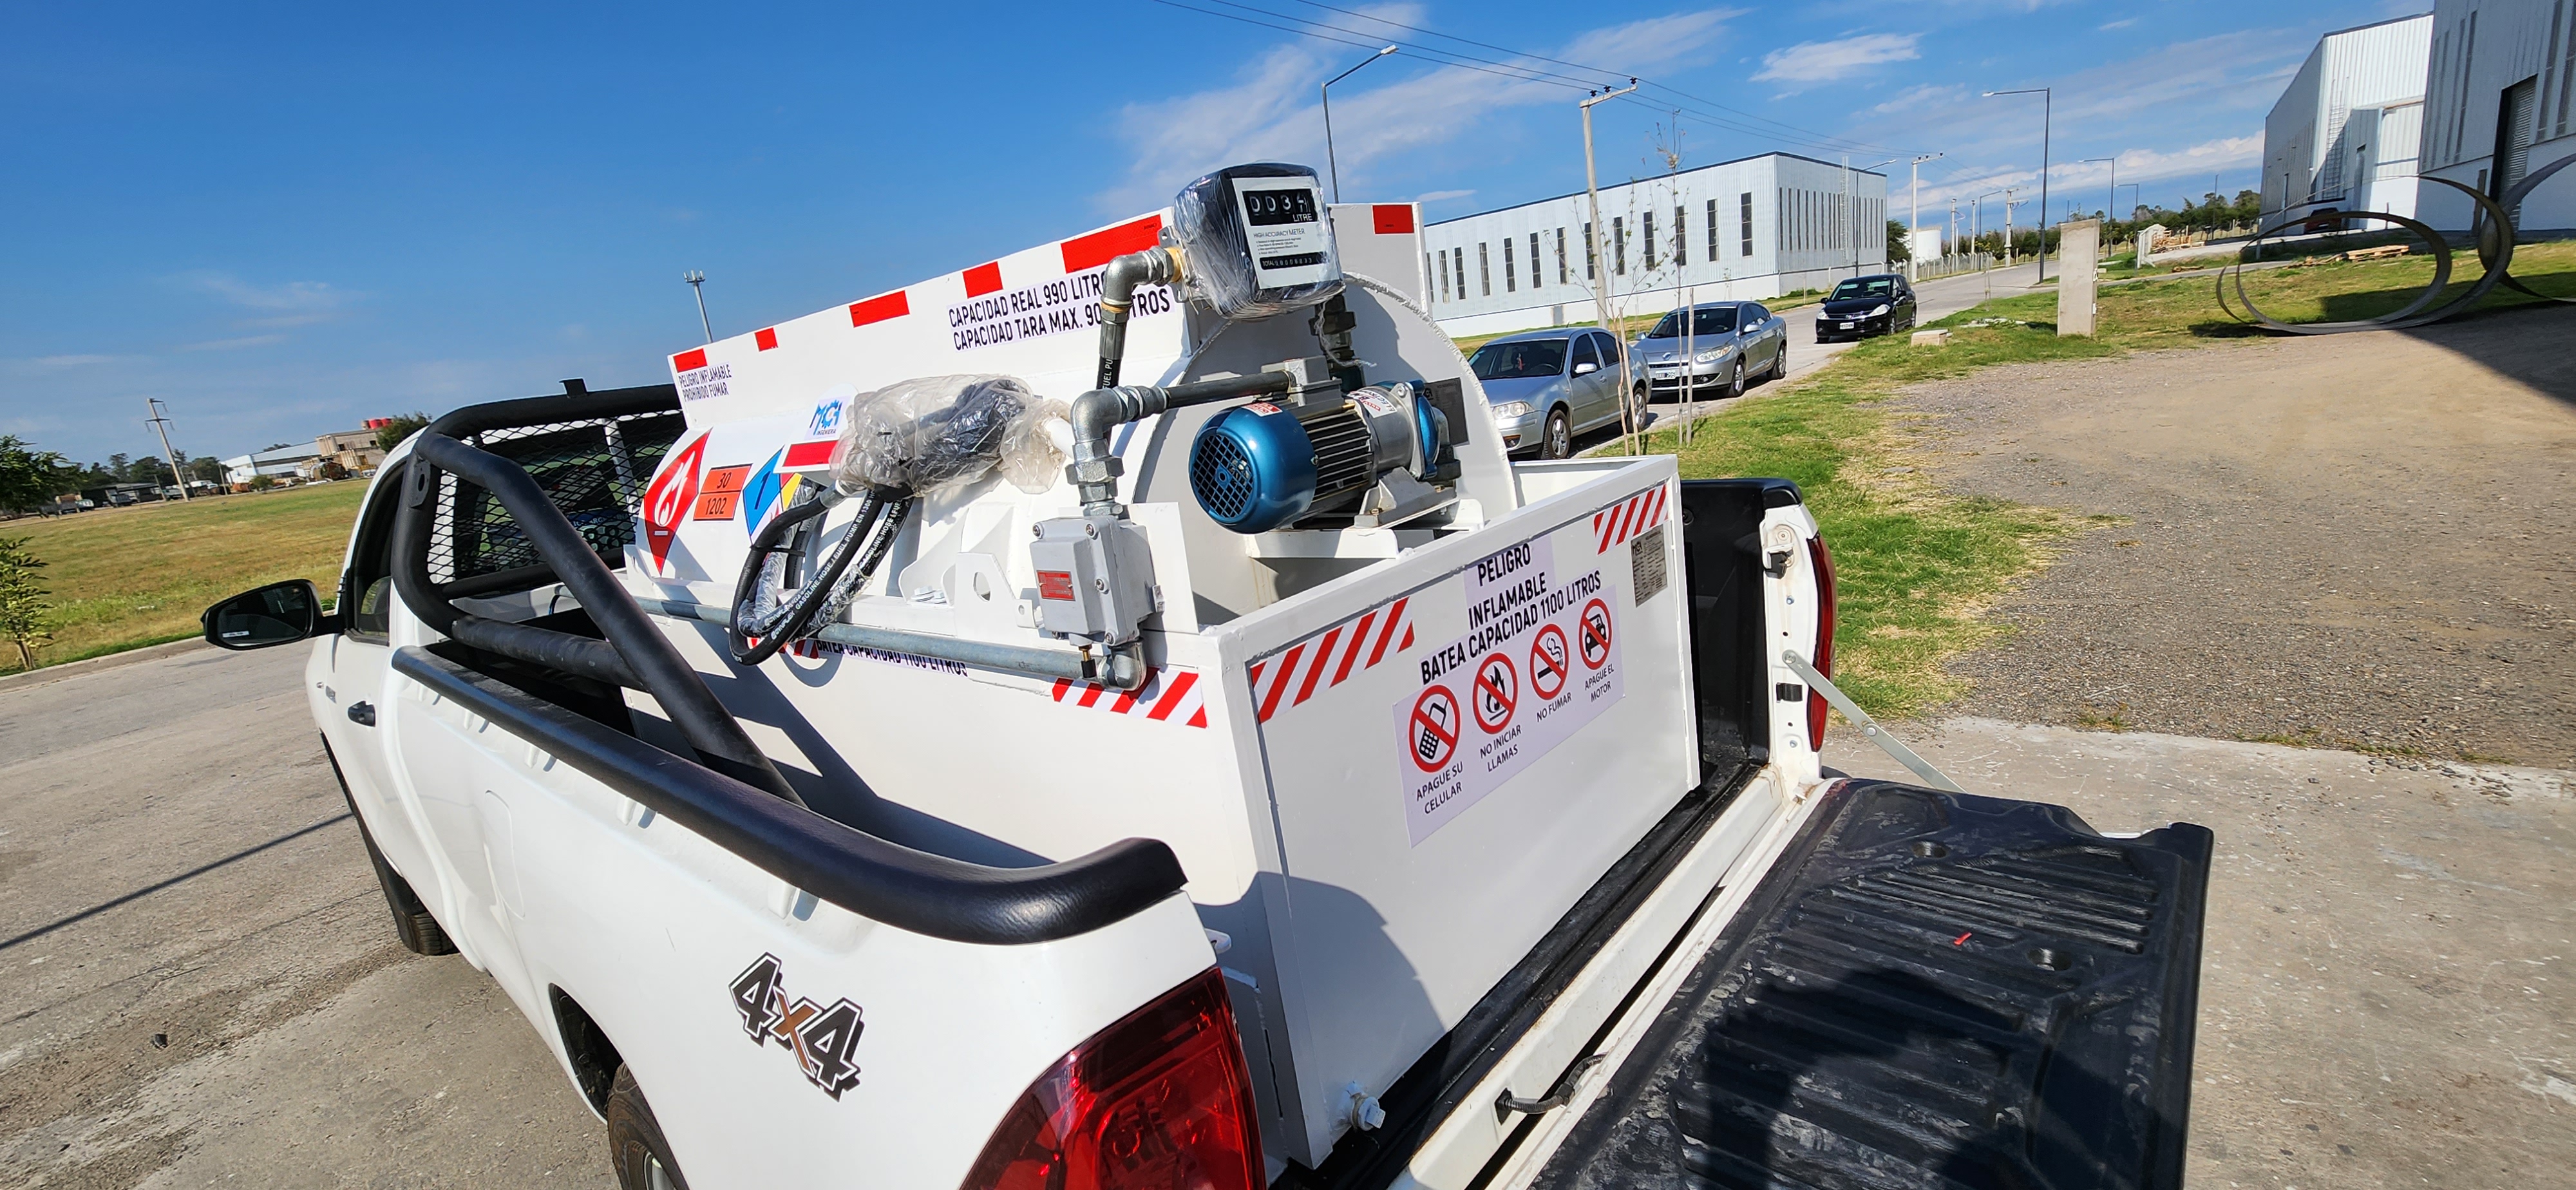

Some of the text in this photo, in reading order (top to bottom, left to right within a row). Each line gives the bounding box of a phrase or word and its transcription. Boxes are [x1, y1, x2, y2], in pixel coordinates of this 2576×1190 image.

[1293, 213, 1313, 222] LITRE
[949, 296, 1009, 328] CAPACIDAD
[1010, 287, 1042, 314] REAL
[1044, 281, 1068, 306] 990
[953, 316, 1013, 351] CAPACIDAD
[1015, 313, 1048, 340] TARA
[1050, 307, 1083, 332] MAX.
[679, 364, 732, 388] PELIGRO INFLAMABLE
[682, 382, 729, 402] PROHIBIDO FUMAR
[717, 472, 732, 489] 30
[705, 497, 727, 515] 1202
[880, 518, 894, 536] HOSE
[795, 580, 820, 610] GASOLINE
[819, 562, 833, 581] HOSE
[845, 522, 859, 543] PUMP
[856, 513, 865, 524] EN
[1478, 543, 1531, 587] PELIGRO
[1468, 571, 1547, 630] INFLAMABLE
[1421, 570, 1601, 685] BATEA CAPACIDAD 1100 LITROS
[1585, 663, 1615, 690] APAGUE EL
[1537, 692, 1572, 722] NO FUMAR
[1591, 681, 1611, 703] MOTOR
[1480, 724, 1521, 759] NO INICIAR
[1488, 744, 1519, 772] LLAMAS
[1417, 761, 1463, 801] APAGUE SU
[1425, 782, 1463, 814] CELULAR
